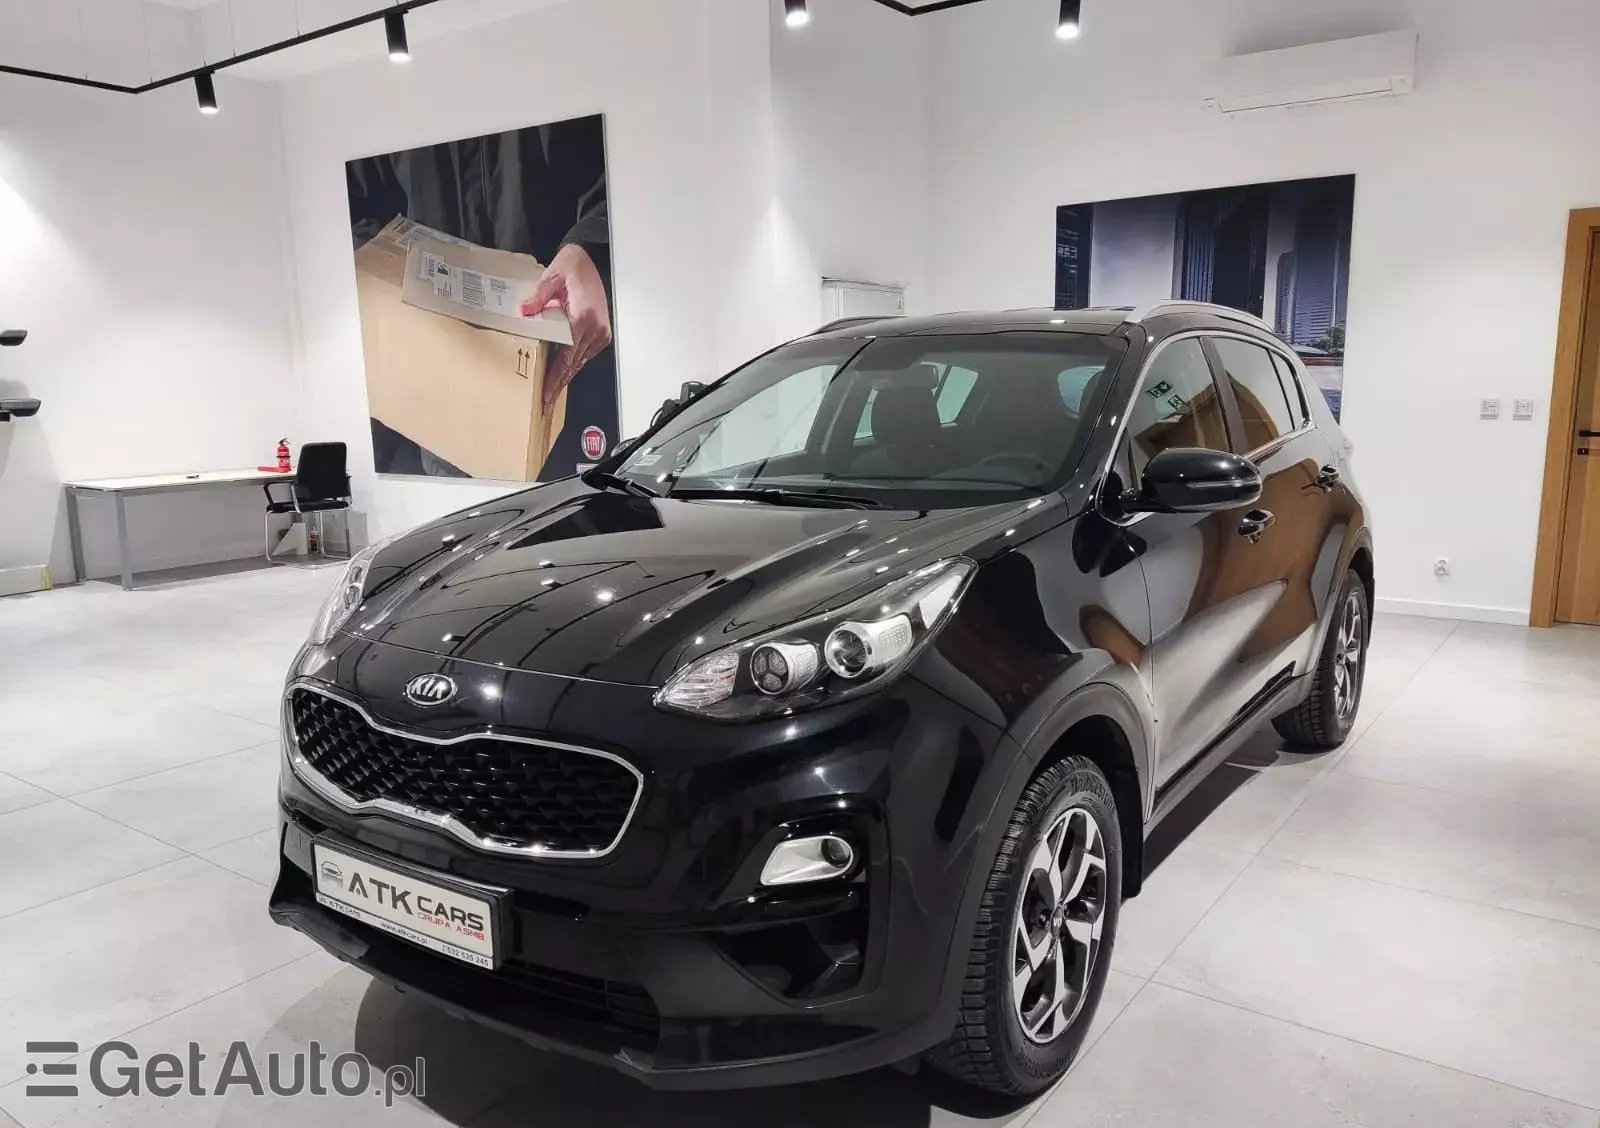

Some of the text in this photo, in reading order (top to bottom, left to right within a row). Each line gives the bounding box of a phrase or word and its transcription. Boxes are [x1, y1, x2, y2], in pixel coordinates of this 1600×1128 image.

[586, 436, 600, 452] FIAT
[410, 676, 446, 699] KIA
[348, 872, 484, 932] ATK CARS
[417, 911, 485, 941] GRUPA ASMB
